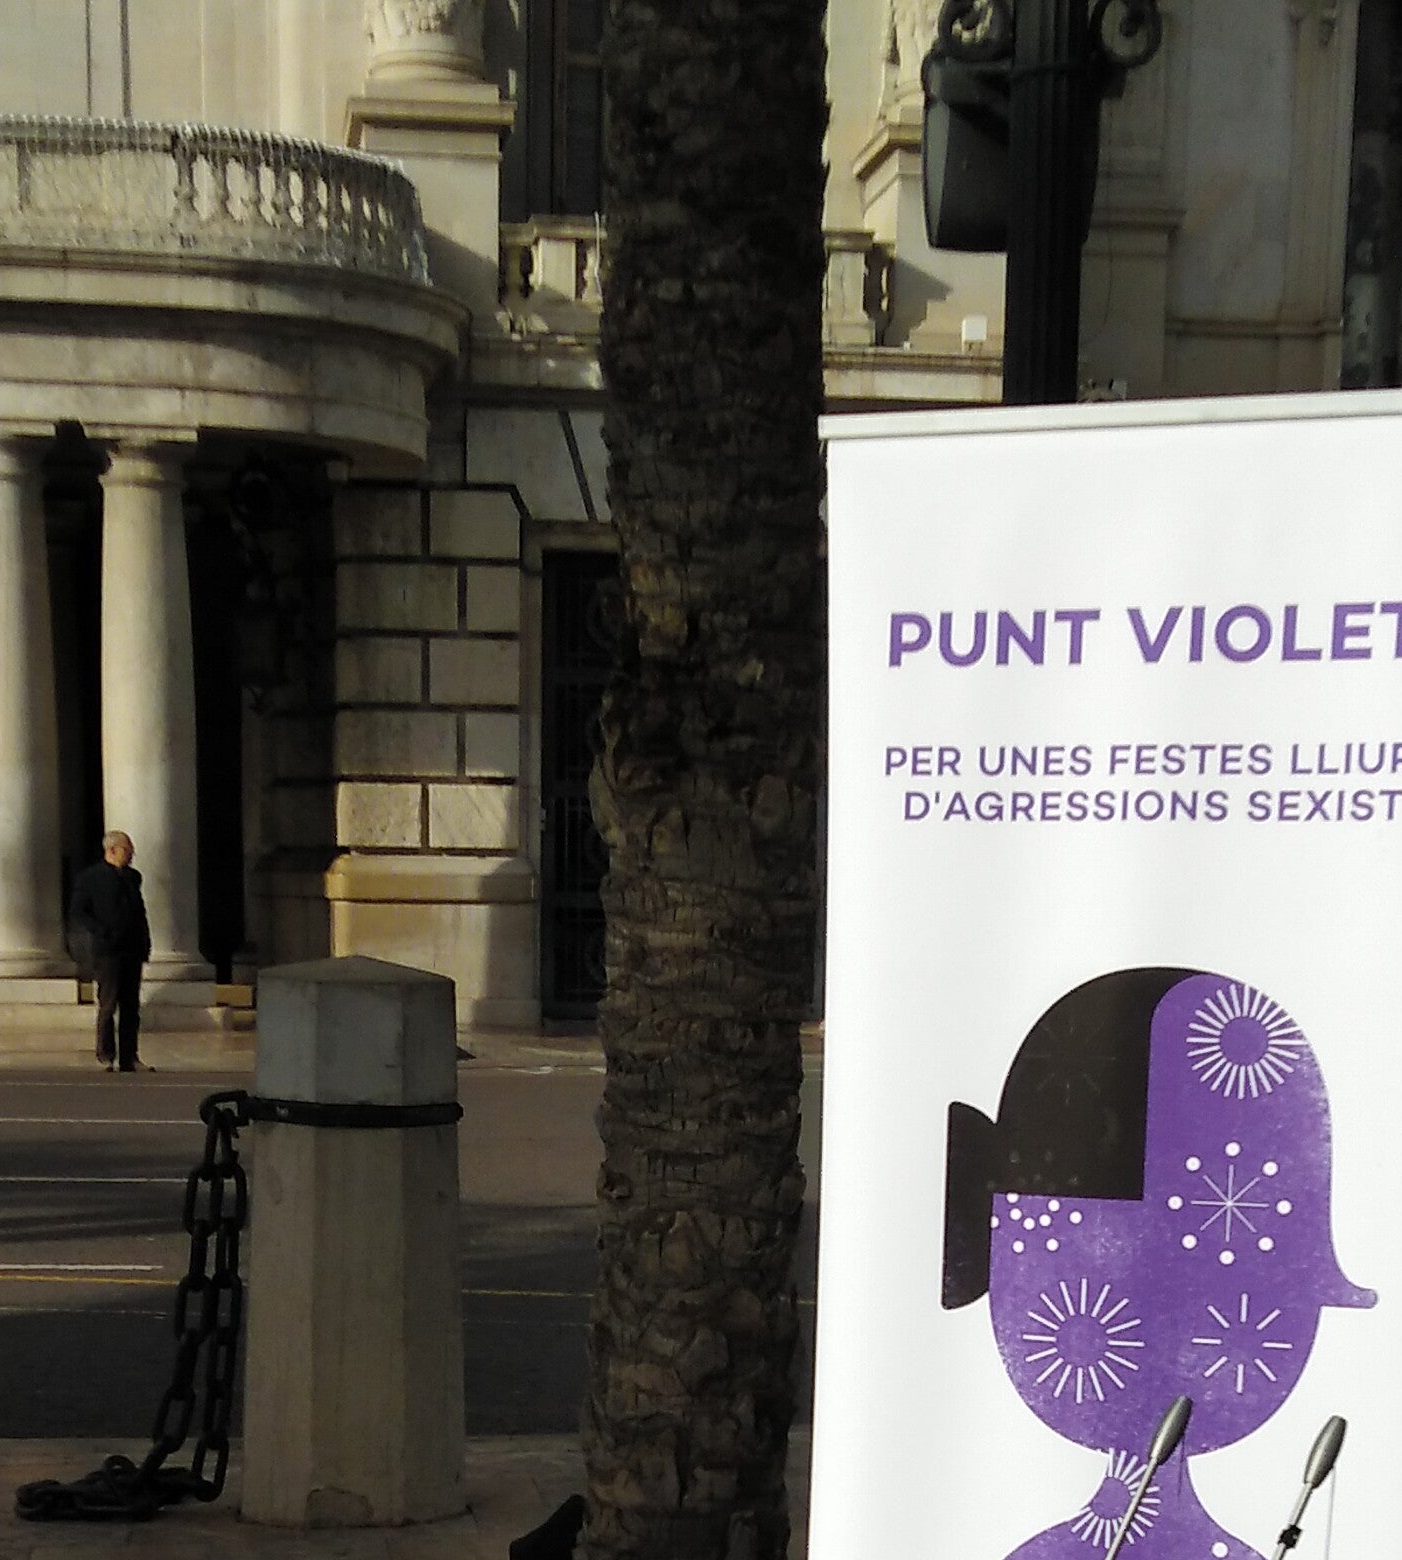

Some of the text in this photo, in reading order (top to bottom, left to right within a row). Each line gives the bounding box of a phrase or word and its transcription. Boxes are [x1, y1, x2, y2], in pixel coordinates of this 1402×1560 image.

[889, 609, 1100, 667] PUNT
[885, 746, 961, 777] PER
[979, 745, 1091, 777] UNES
[1109, 743, 1272, 776] FESTES
[904, 789, 1229, 822] D'AGRESSIONS
